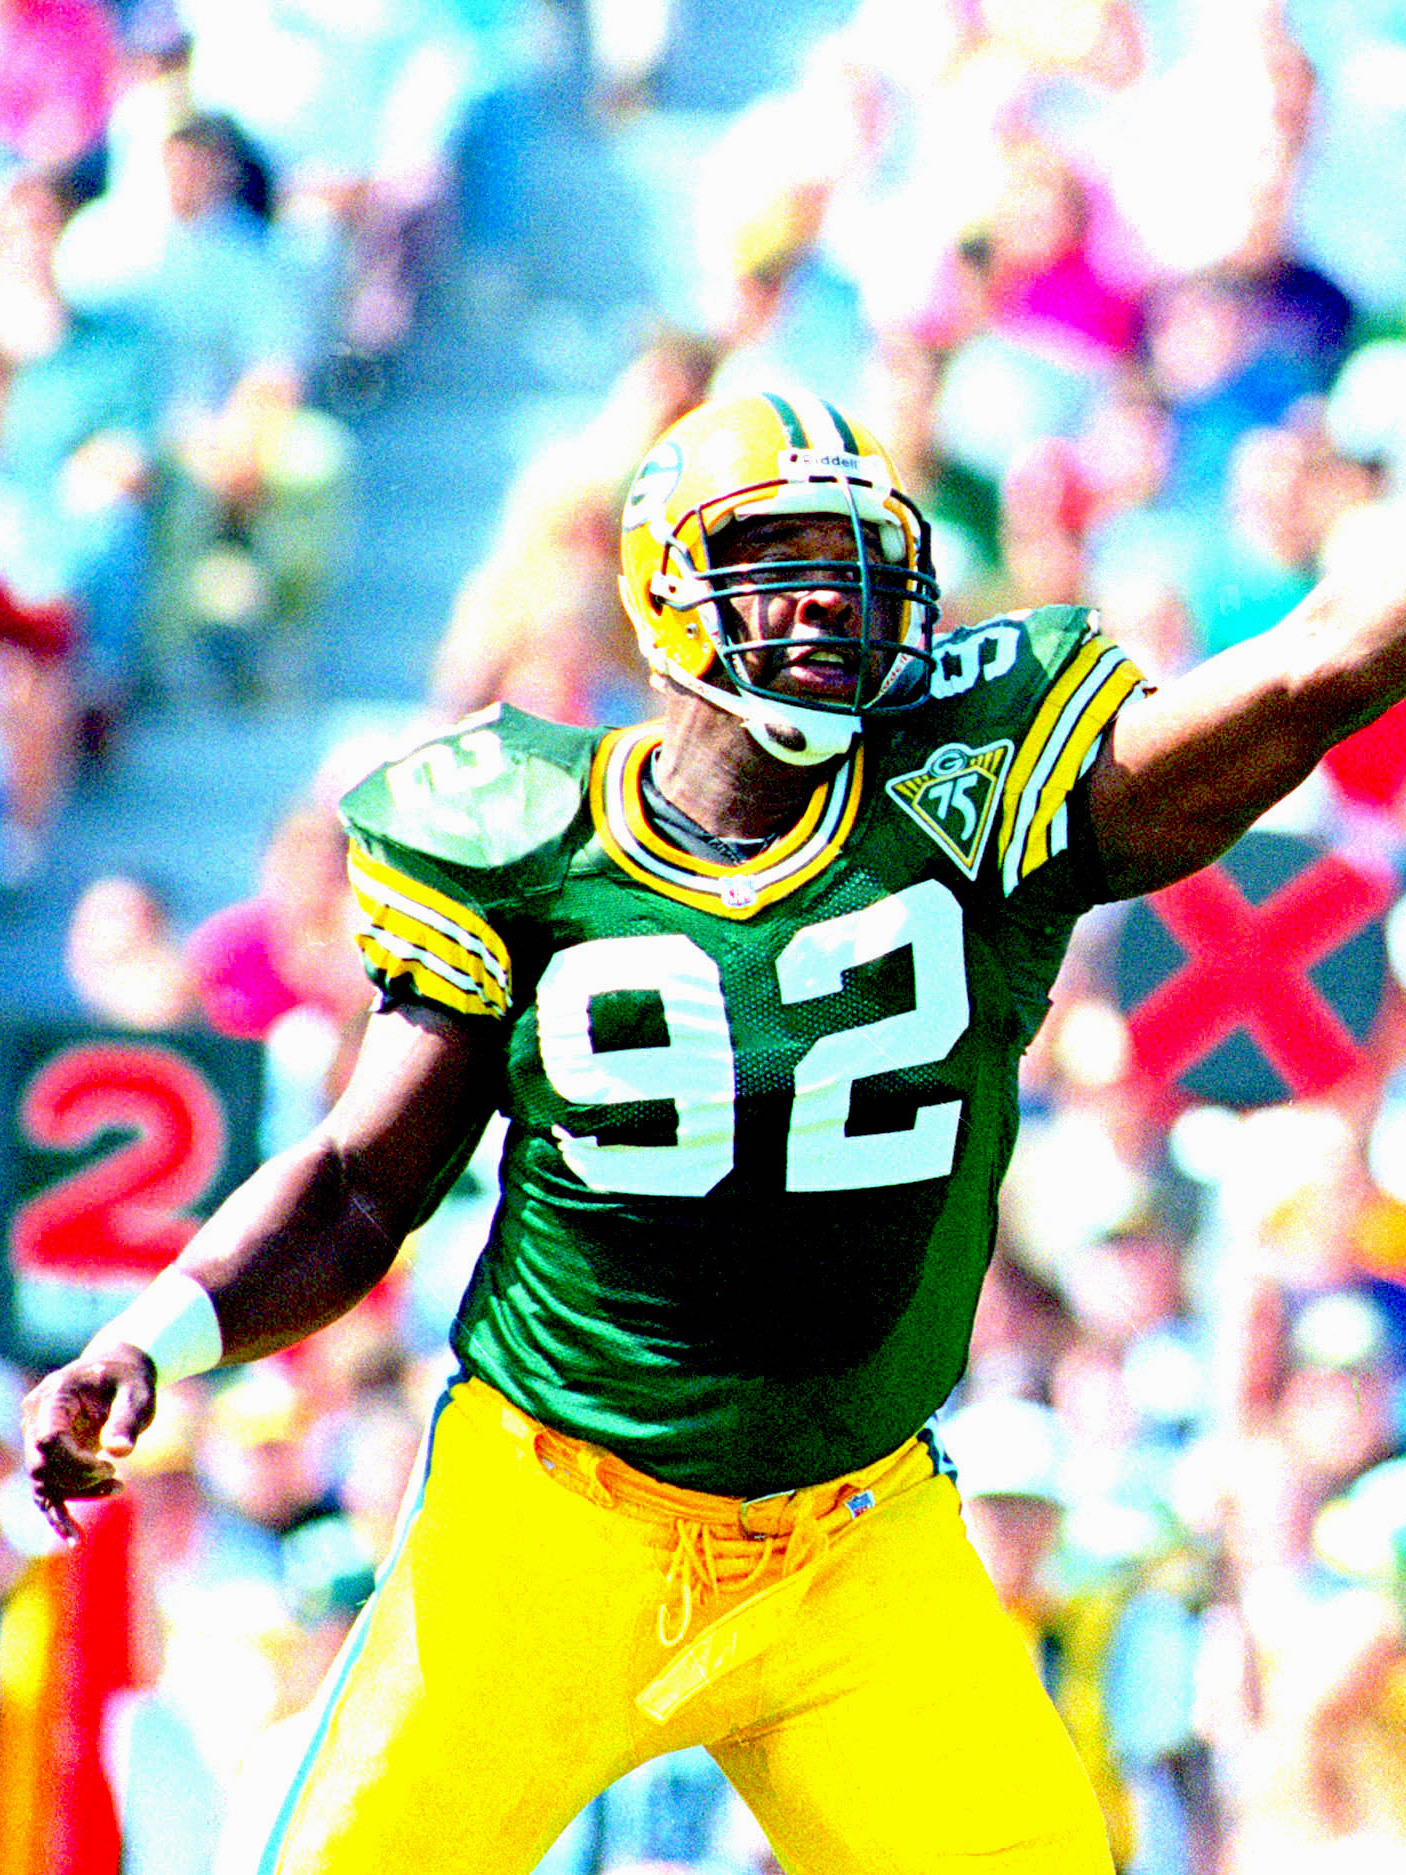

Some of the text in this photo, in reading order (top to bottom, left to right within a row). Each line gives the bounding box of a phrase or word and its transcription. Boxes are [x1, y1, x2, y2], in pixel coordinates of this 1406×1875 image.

[928, 773, 979, 841] 75
[536, 878, 969, 1198] 92
[10, 1044, 226, 1284] 2
